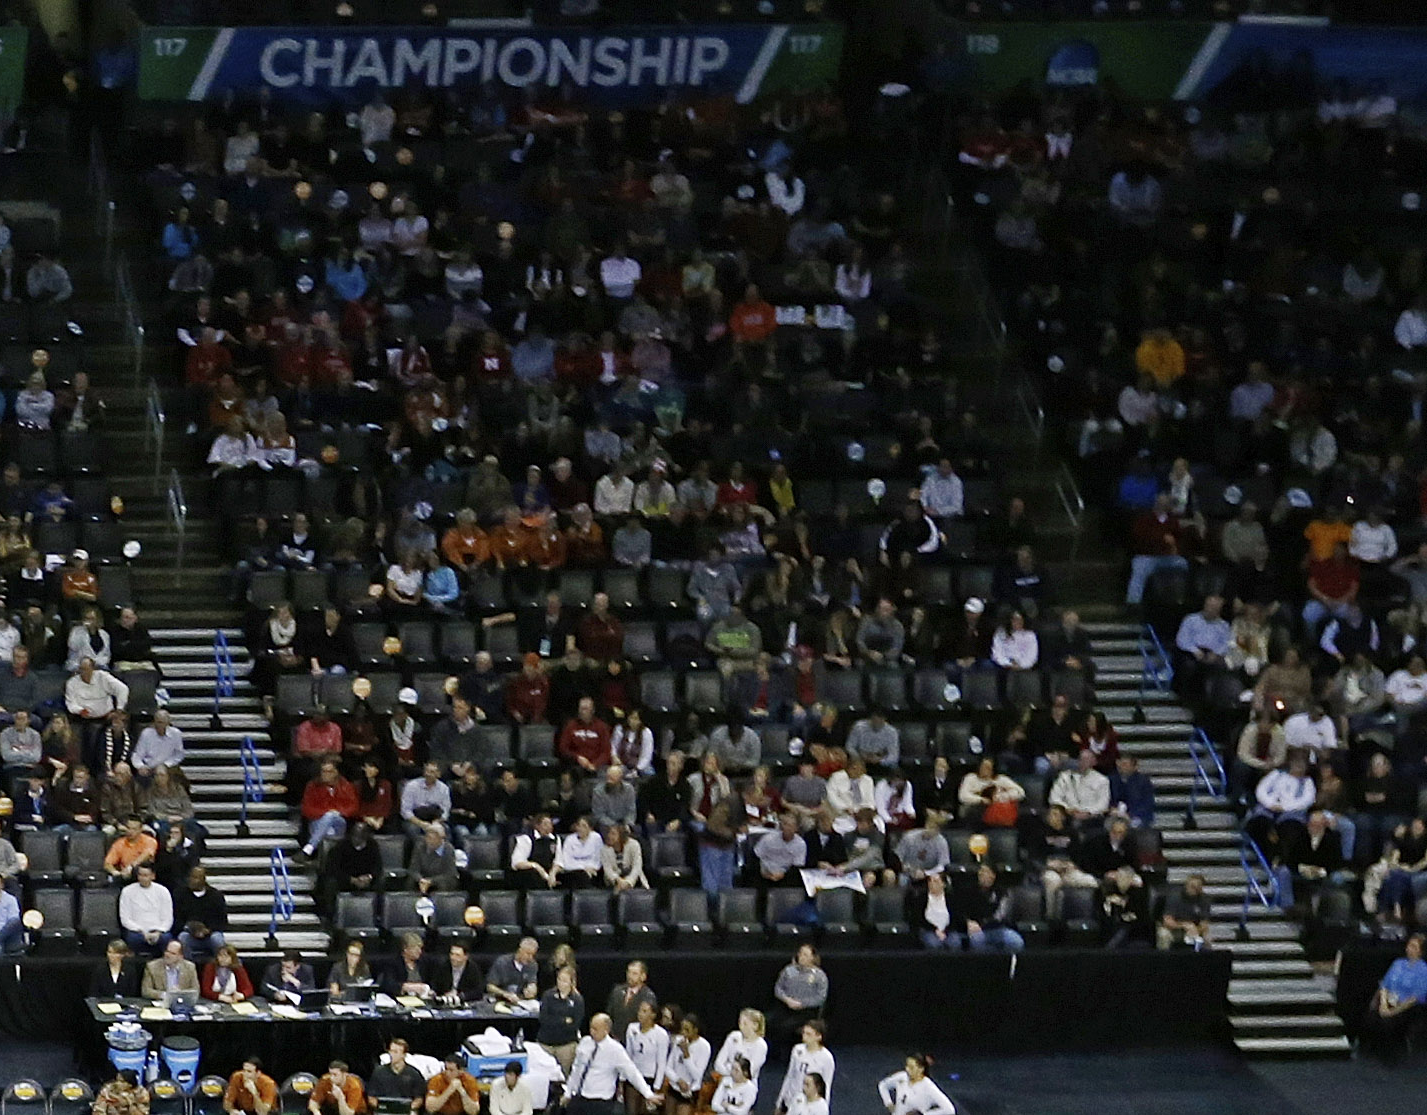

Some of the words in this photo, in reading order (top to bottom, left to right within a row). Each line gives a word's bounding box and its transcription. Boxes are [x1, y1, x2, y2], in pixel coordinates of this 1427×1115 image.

[152, 37, 188, 56] 117
[788, 35, 823, 54] 117
[259, 37, 730, 89] CHAMPIONSHIP
